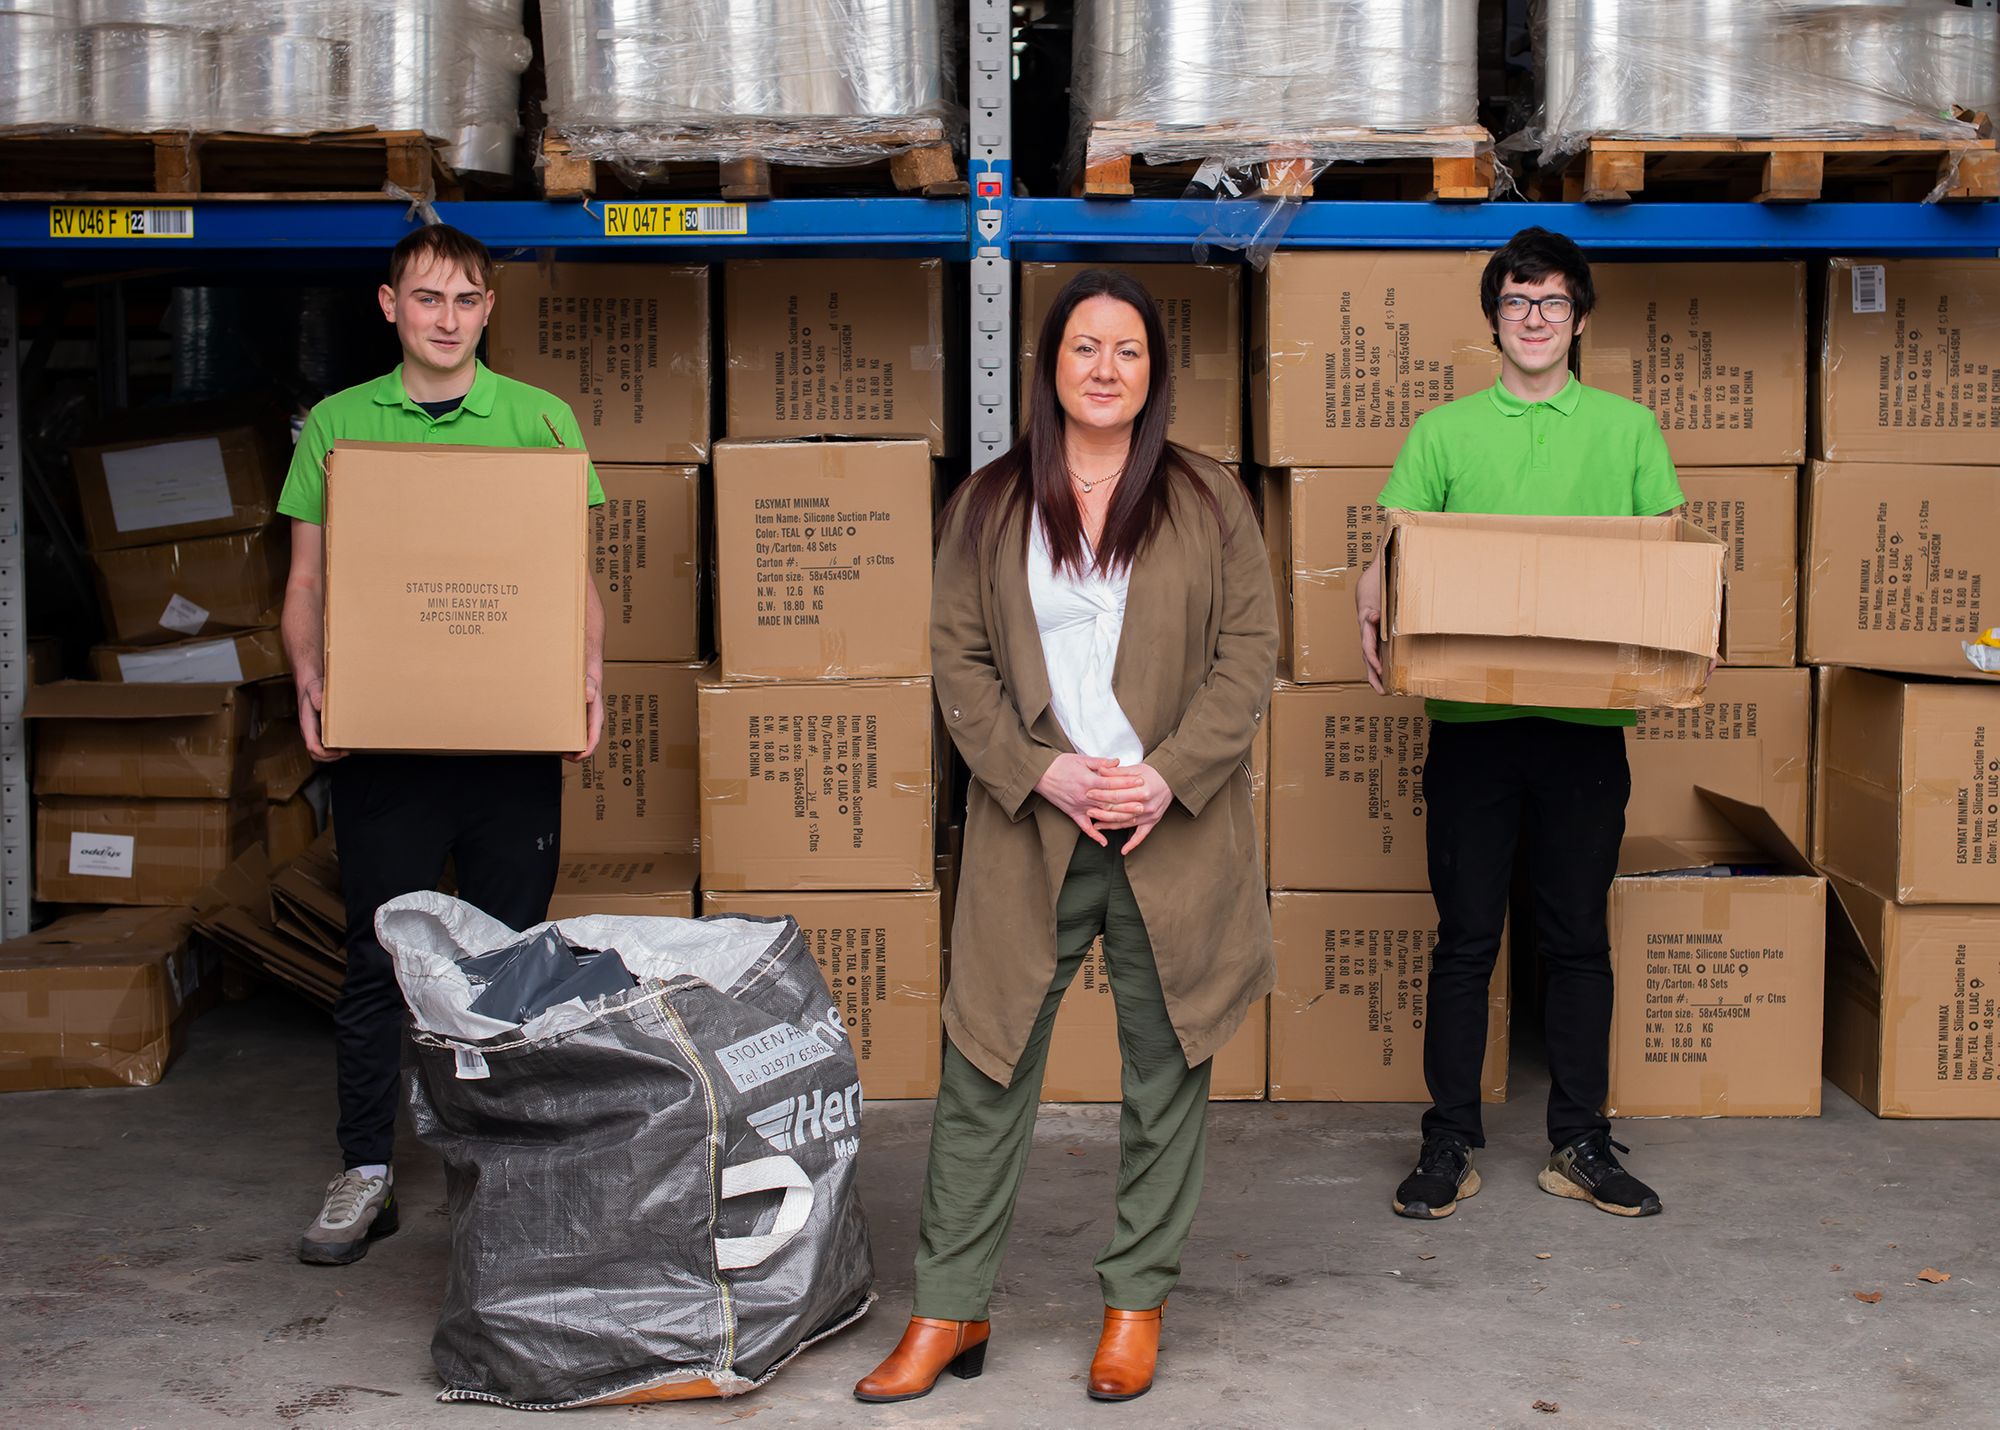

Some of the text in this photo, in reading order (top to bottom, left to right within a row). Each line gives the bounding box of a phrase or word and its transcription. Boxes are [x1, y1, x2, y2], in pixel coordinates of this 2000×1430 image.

[53, 209, 144, 234] RV 046 F 22
[608, 207, 698, 232] RV 047 F 50
[1340, 291, 1351, 428] Item Name: Silicone Suction Plate
[1325, 353, 1336, 428] EASYMAT MINIMAX
[1743, 370, 1754, 429] MADE IN CHINA
[1878, 355, 1890, 427] EASYMAT MINIMAX
[755, 498, 830, 509] EASYMAT MINIMAX
[756, 511, 890, 524] Item Name: Silicone Suction Plate
[636, 500, 646, 568] EASYMAT MINIMAX
[756, 526, 843, 539] Color: TEAL LILAC
[1347, 506, 1357, 568] MADE IN CHINA
[1734, 501, 1744, 572] EASYMAT MINIMAX
[806, 542, 817, 552] 48
[819, 541, 837, 552] Sets
[757, 557, 783, 568] Carton
[853, 555, 861, 566] of
[876, 555, 895, 565] Ctns
[406, 583, 519, 595] STATUS PRODUCTS LTD
[757, 570, 860, 583] Carton size: 58x45x49CM
[428, 598, 500, 609] MINI EASY MAT
[757, 585, 824, 597] N.W: 12.6 KG
[1858, 559, 1871, 630] EASYMAT MINIMAX
[420, 611, 508, 622] 24PCS/INNER BOX
[758, 600, 823, 612] G.W: 18.80 KG
[758, 615, 820, 626] MADE IN CHINA
[648, 695, 659, 763] EASYMAT MINIMAX
[1747, 703, 1757, 737] EASYMAT
[749, 716, 760, 777] MADE IN CHINA
[866, 715, 877, 789] EASYMAT MINIMAX
[1324, 716, 1335, 777] MADE IN CHINA
[1339, 716, 1350, 781] G.W: 18.80 KG
[851, 715, 863, 848] Item Name: Silicone Suction Plate
[1957, 788, 1968, 864] EASYMAT MINIMAX
[1647, 934, 1723, 945] EASYMAT MINIMAX
[875, 928, 886, 1001] EASYMAT MINIMAX
[1354, 930, 1365, 996] N.W: 12.6 KG
[1647, 949, 1784, 959] Item Name: Silicone Suction Plate
[1084, 965, 1094, 990] CHINA
[1368, 930, 1379, 1031] Carton size: 58x45x49CM
[1647, 963, 1735, 974] Color: TEAL LILAC
[861, 929, 872, 1060] Item Name: Silicone Suction Plate
[1697, 978, 1708, 989] 48
[1710, 978, 1728, 989] Sets
[1646, 993, 1673, 1004] Carton
[1744, 993, 1752, 1004] of
[1768, 993, 1786, 1004] Ctns
[1646, 1008, 1750, 1019] Carton size: 58x45x49CM
[1646, 1023, 1713, 1033] N.W: 12.6 KG
[727, 1031, 785, 1065] STOLEN
[1645, 1037, 1712, 1048] G.W: 18.80 KG
[1937, 1005, 1949, 1080] EASYMAT MINIMAX
[737, 1069, 762, 1085] Tel:
[761, 1053, 796, 1076] 01977
[1645, 1052, 1707, 1063] MADE IN CHINA
